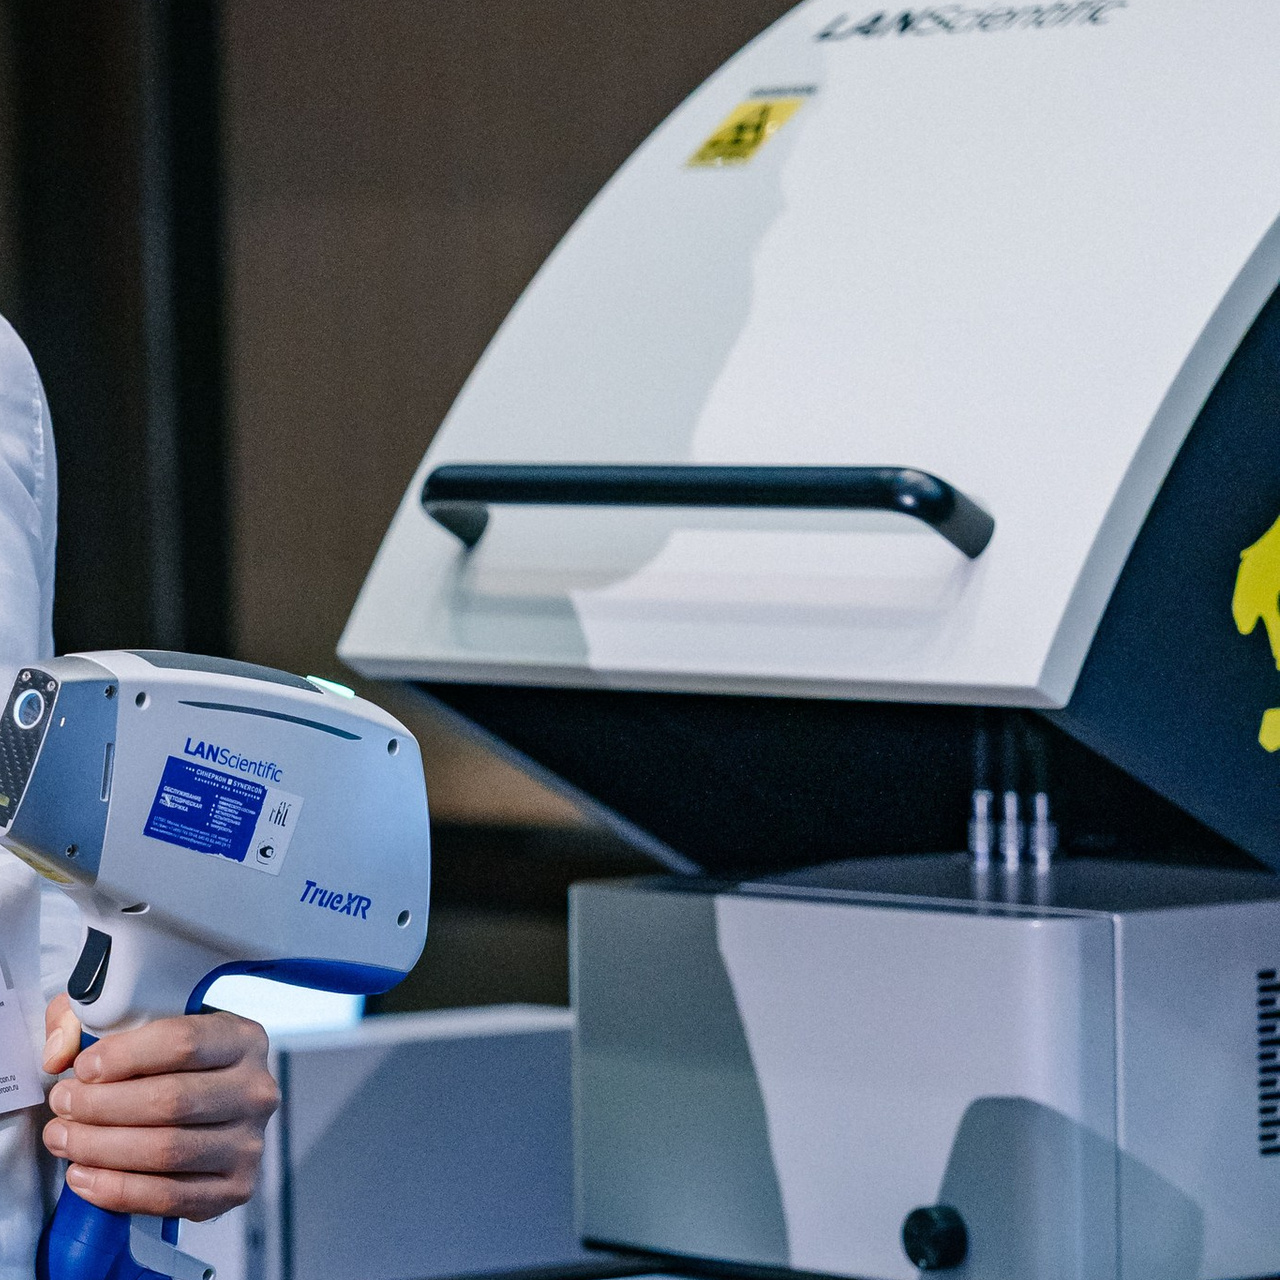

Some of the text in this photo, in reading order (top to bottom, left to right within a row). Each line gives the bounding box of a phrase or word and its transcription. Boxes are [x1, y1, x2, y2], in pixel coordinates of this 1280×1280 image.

[184, 737, 283, 783] LANScientific
[196, 768, 263, 795] СИНЕРКОН SYNERCON
[300, 880, 372, 920] TrueXR
